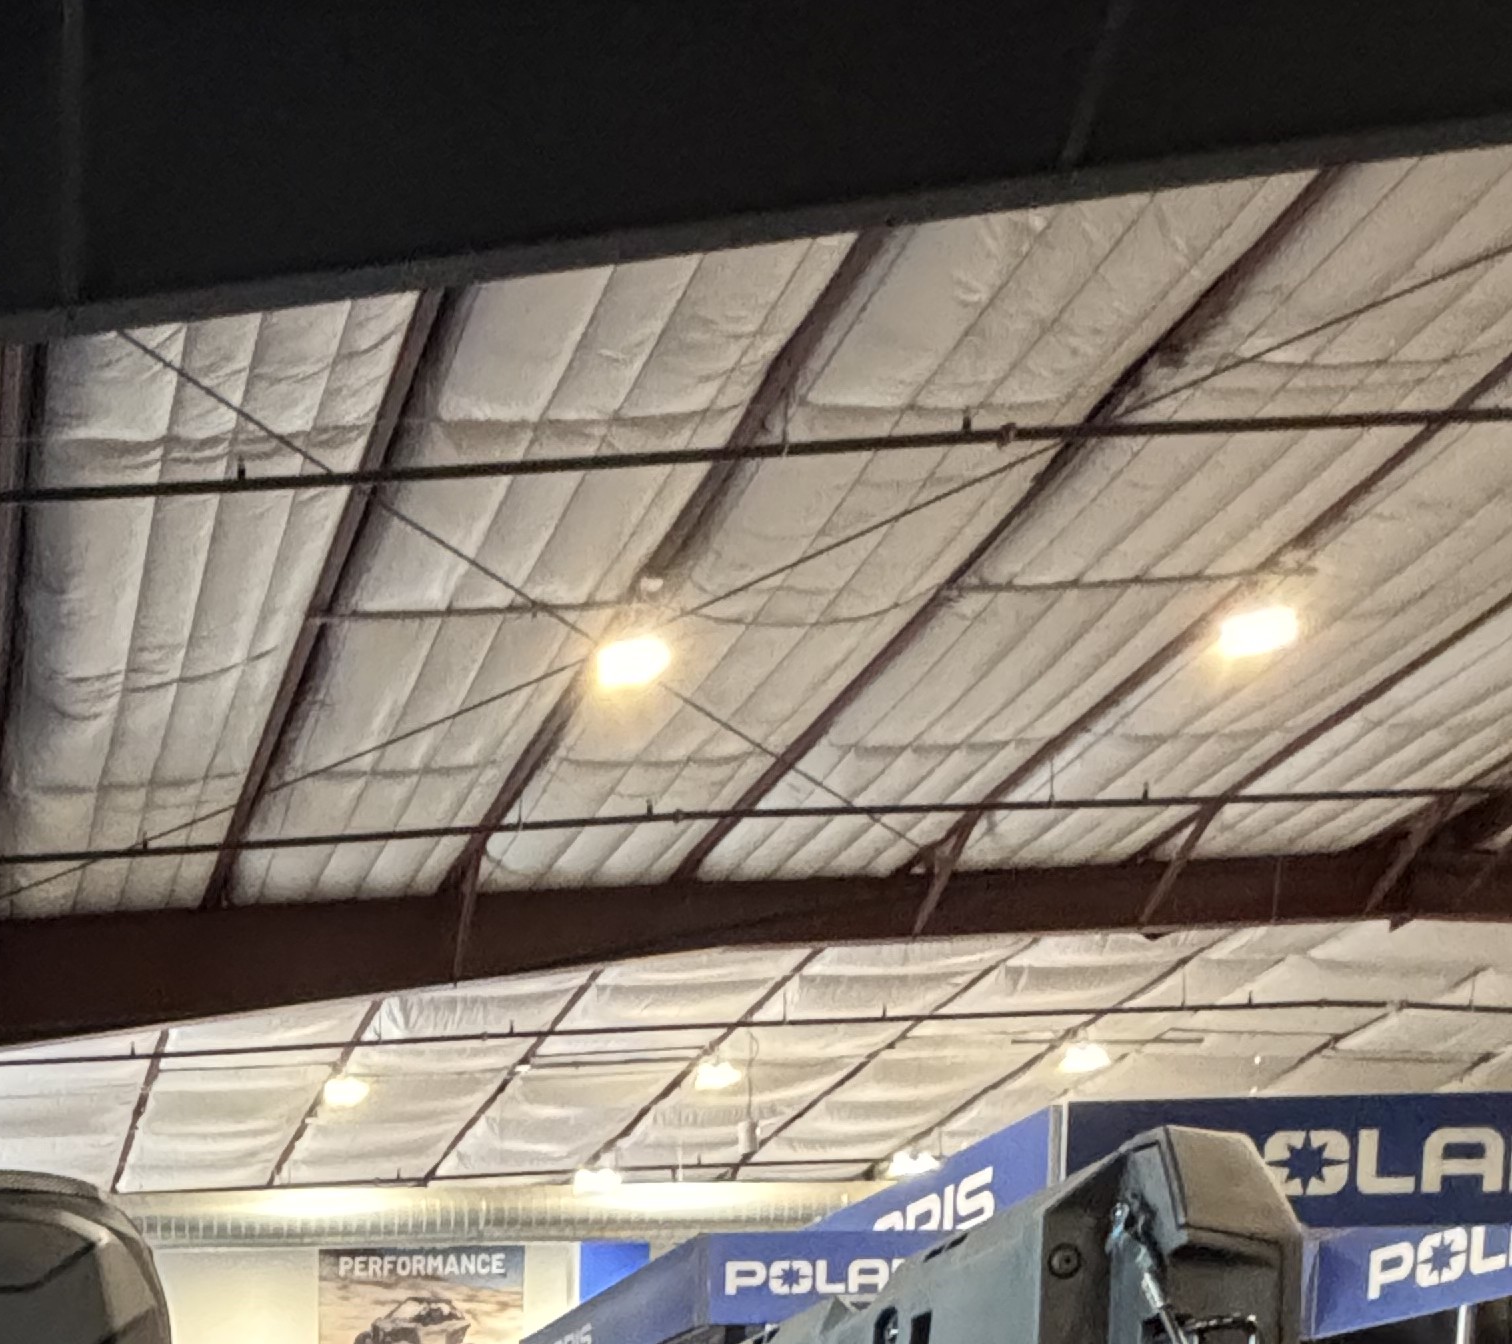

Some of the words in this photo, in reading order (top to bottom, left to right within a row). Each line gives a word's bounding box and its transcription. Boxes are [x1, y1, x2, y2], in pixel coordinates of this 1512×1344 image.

[1264, 1126, 1512, 1196] OLA
[872, 1165, 996, 1232] RIS
[338, 1253, 506, 1279] PERFORMANCE
[724, 1257, 906, 1297] POLA
[1366, 1225, 1512, 1301] POL
